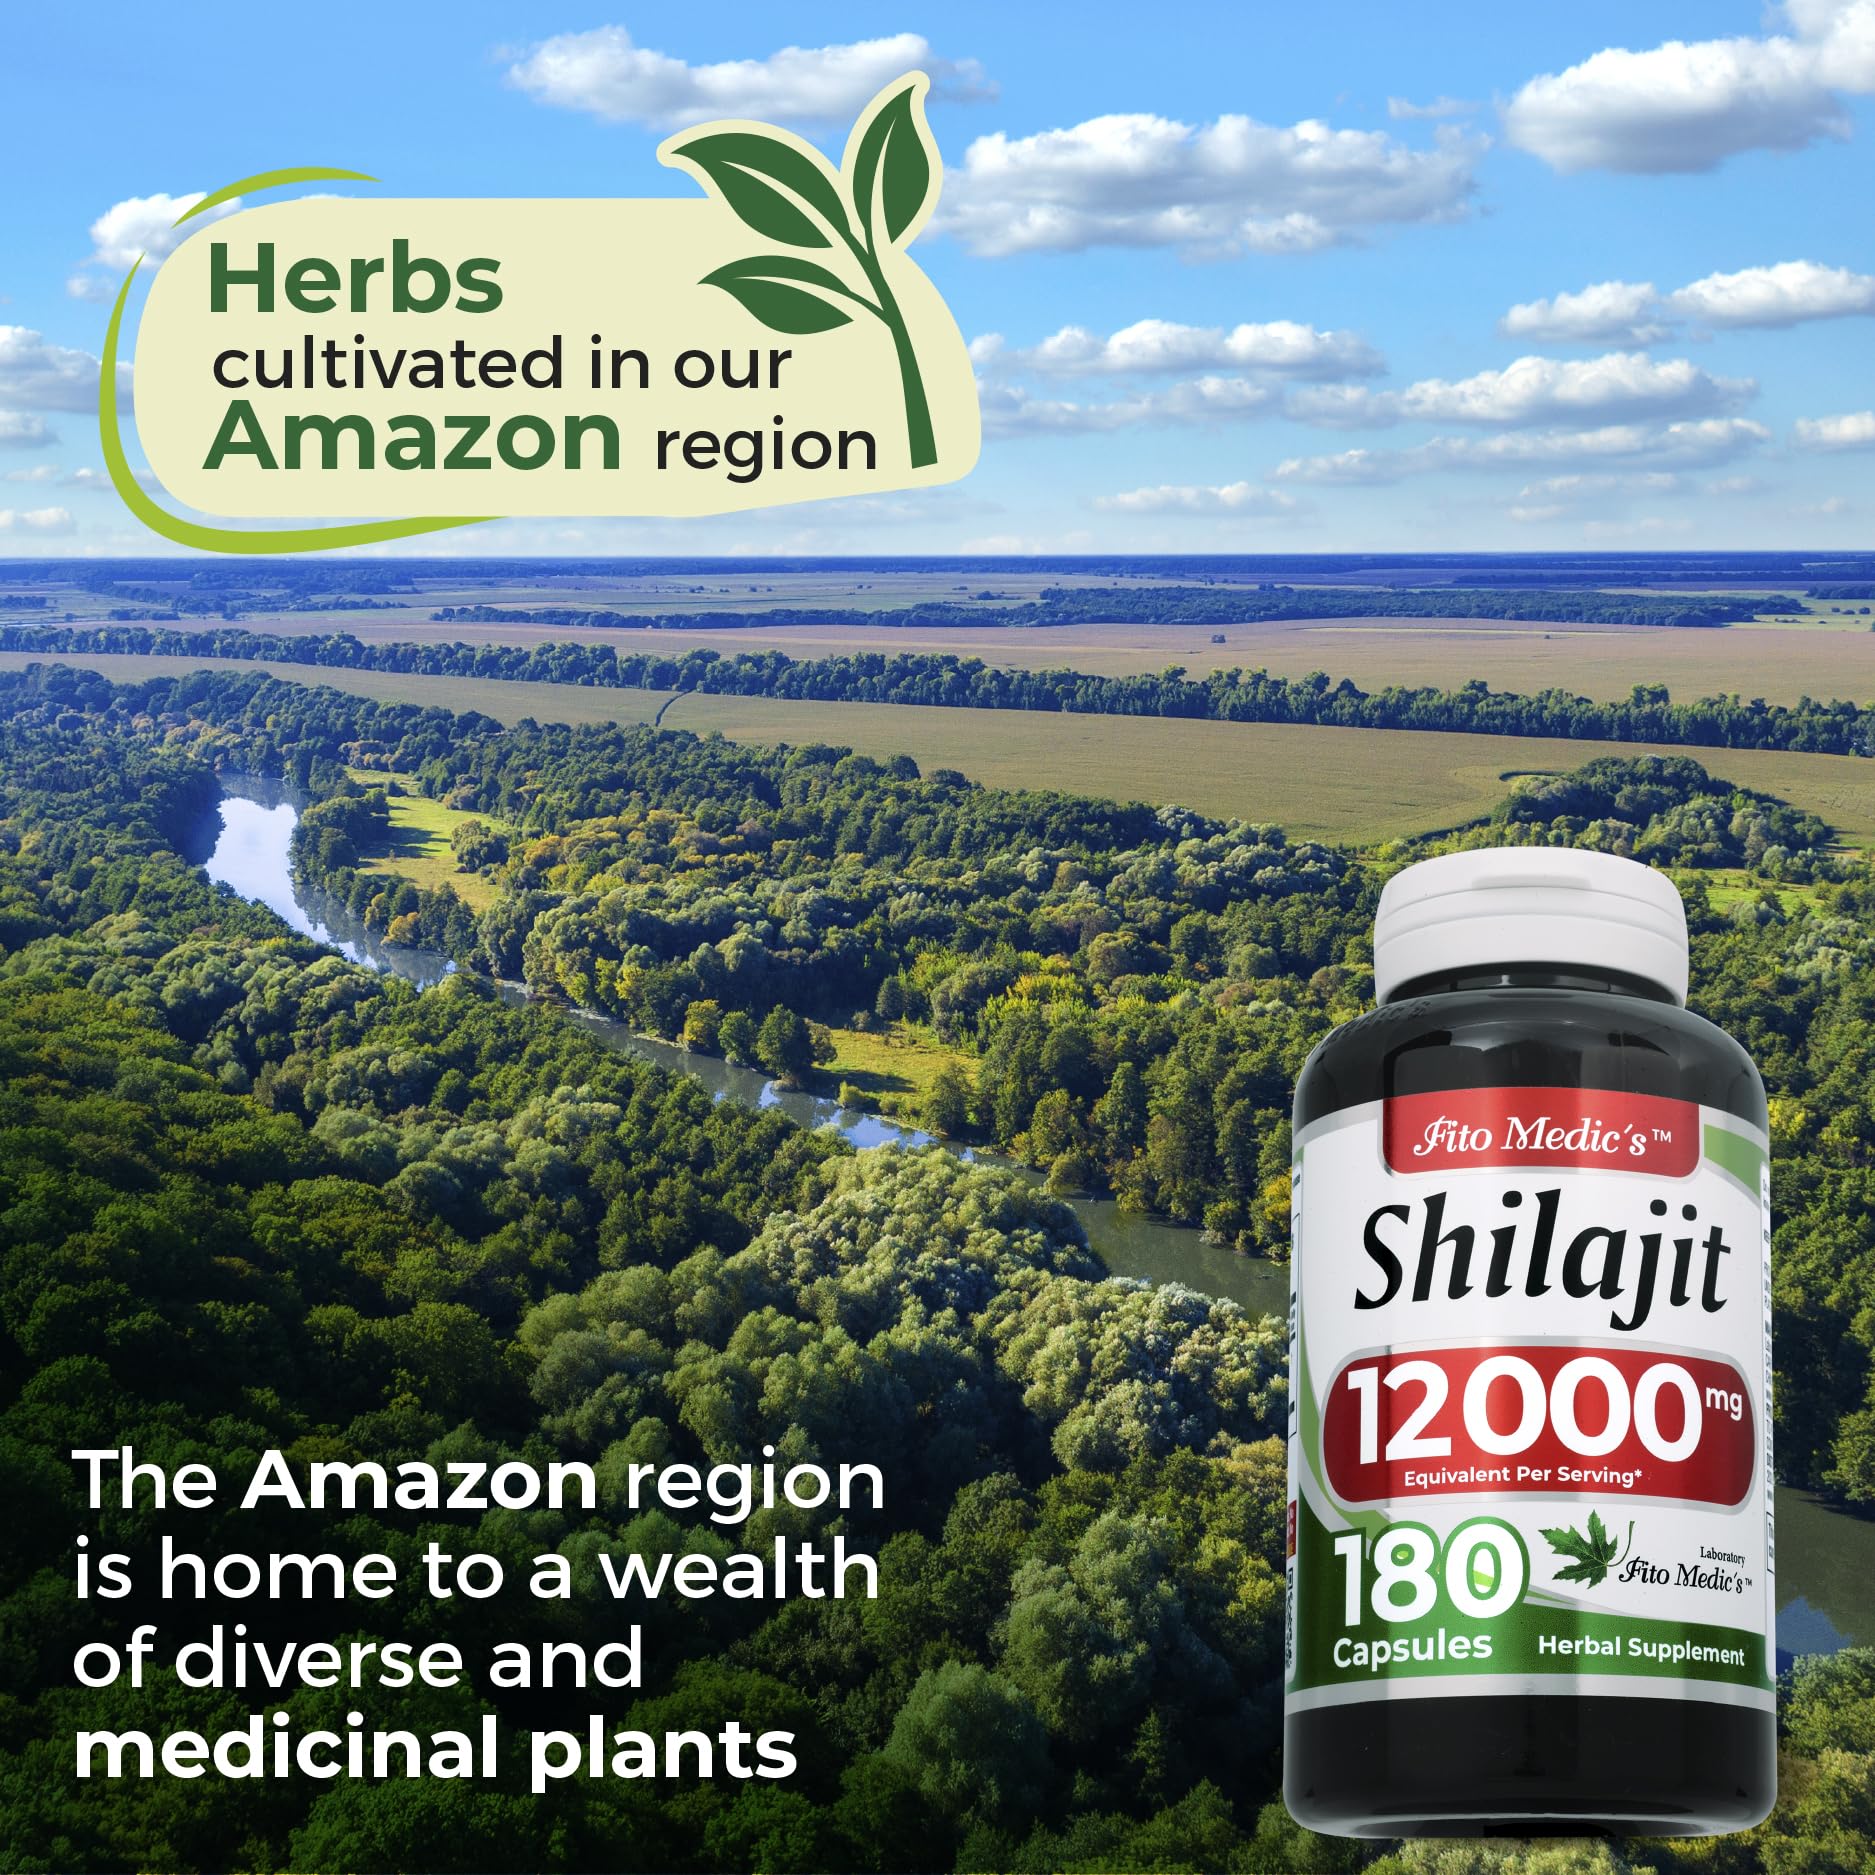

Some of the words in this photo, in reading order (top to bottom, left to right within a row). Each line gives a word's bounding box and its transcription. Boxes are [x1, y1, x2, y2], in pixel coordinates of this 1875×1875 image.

[1413, 1115, 1493, 1156] Fito
[1354, 1188, 1731, 1331] Shilajit
[1347, 1355, 1703, 1463] 12000
[1705, 1386, 1742, 1421] mg
[1404, 1466, 1511, 1488] Equivalent
[1517, 1466, 1552, 1482] Per
[1334, 1522, 1524, 1627] 180
[1618, 1556, 1670, 1585] Fito
[1700, 1546, 1746, 1568] Laboratory
[1333, 1628, 1493, 1671] Capsules
[1539, 1635, 1621, 1656] Herbal
[1628, 1637, 1745, 1666] Supplement
